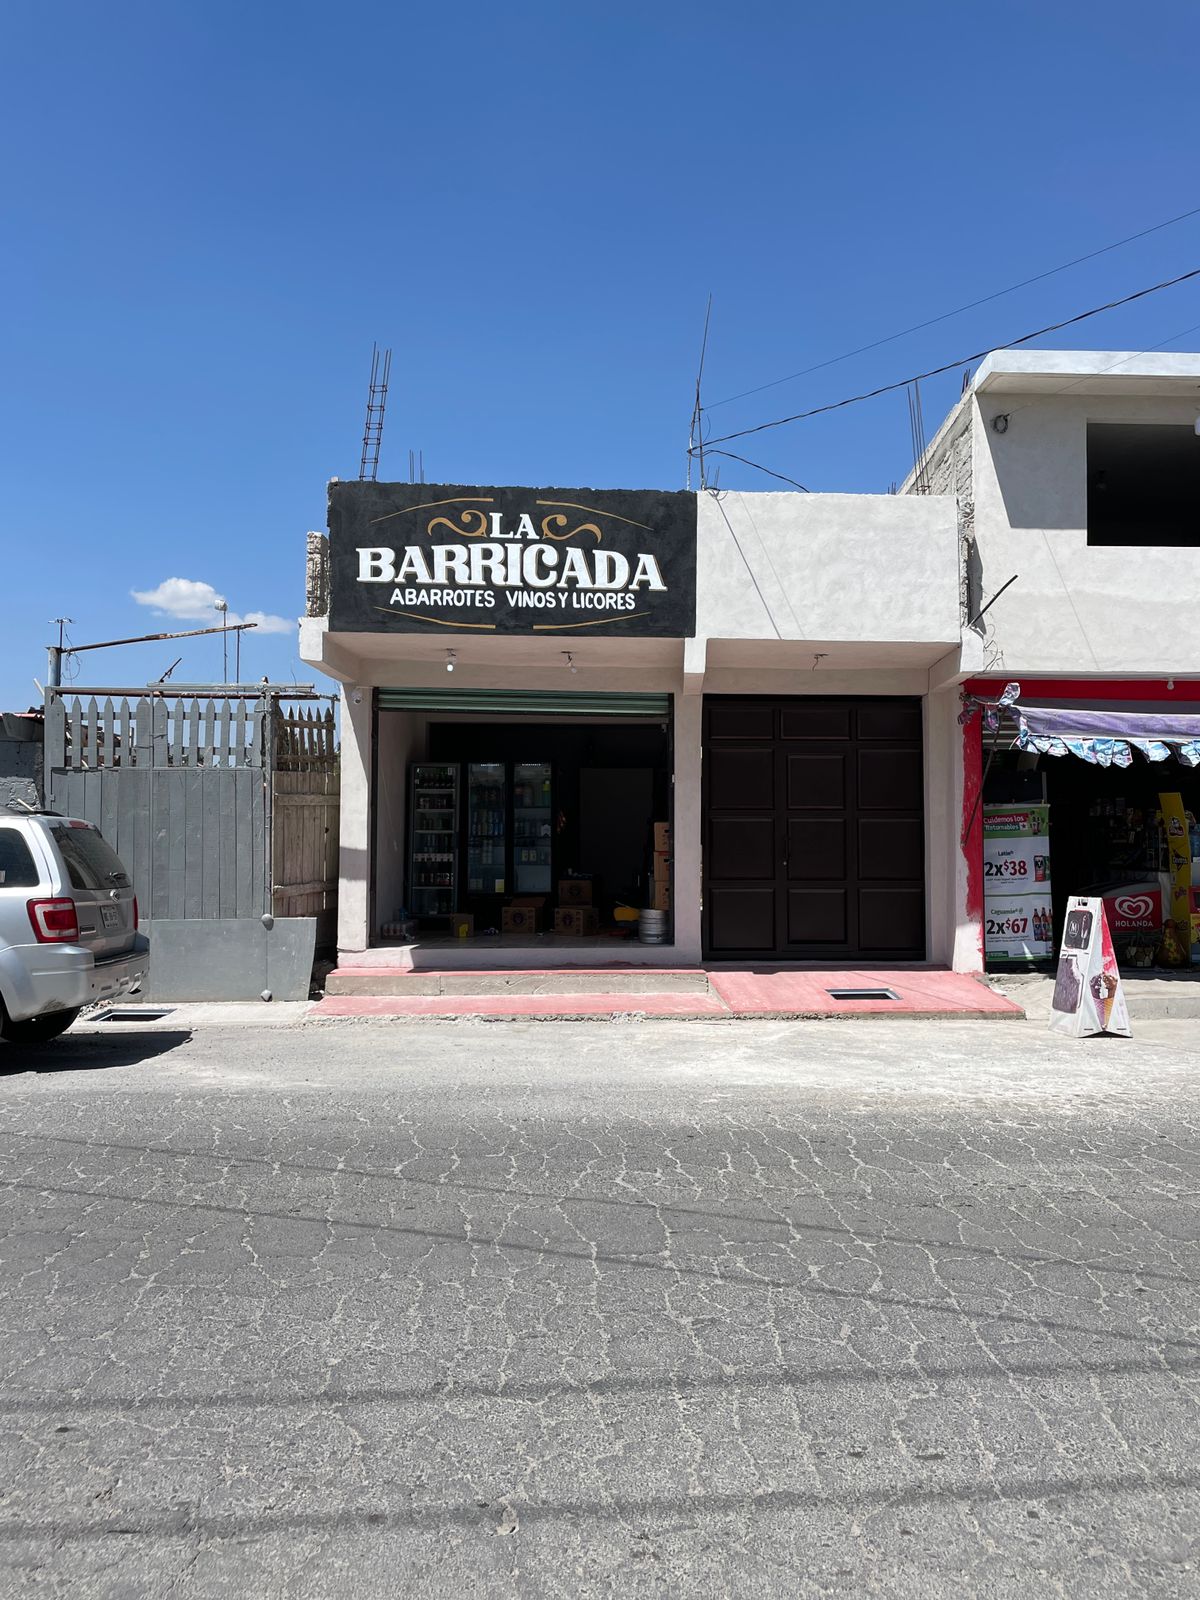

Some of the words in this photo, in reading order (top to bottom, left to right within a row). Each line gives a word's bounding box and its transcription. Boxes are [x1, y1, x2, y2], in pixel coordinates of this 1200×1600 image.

[489, 512, 540, 539] LA
[356, 543, 668, 591] BARRICADA
[389, 588, 496, 608] ABARROTES
[506, 591, 556, 609] VINOS
[558, 592, 570, 609] Y
[572, 592, 636, 610] LICORES
[984, 860, 1027, 876] 2x$38
[986, 917, 1028, 935] 2x$67
